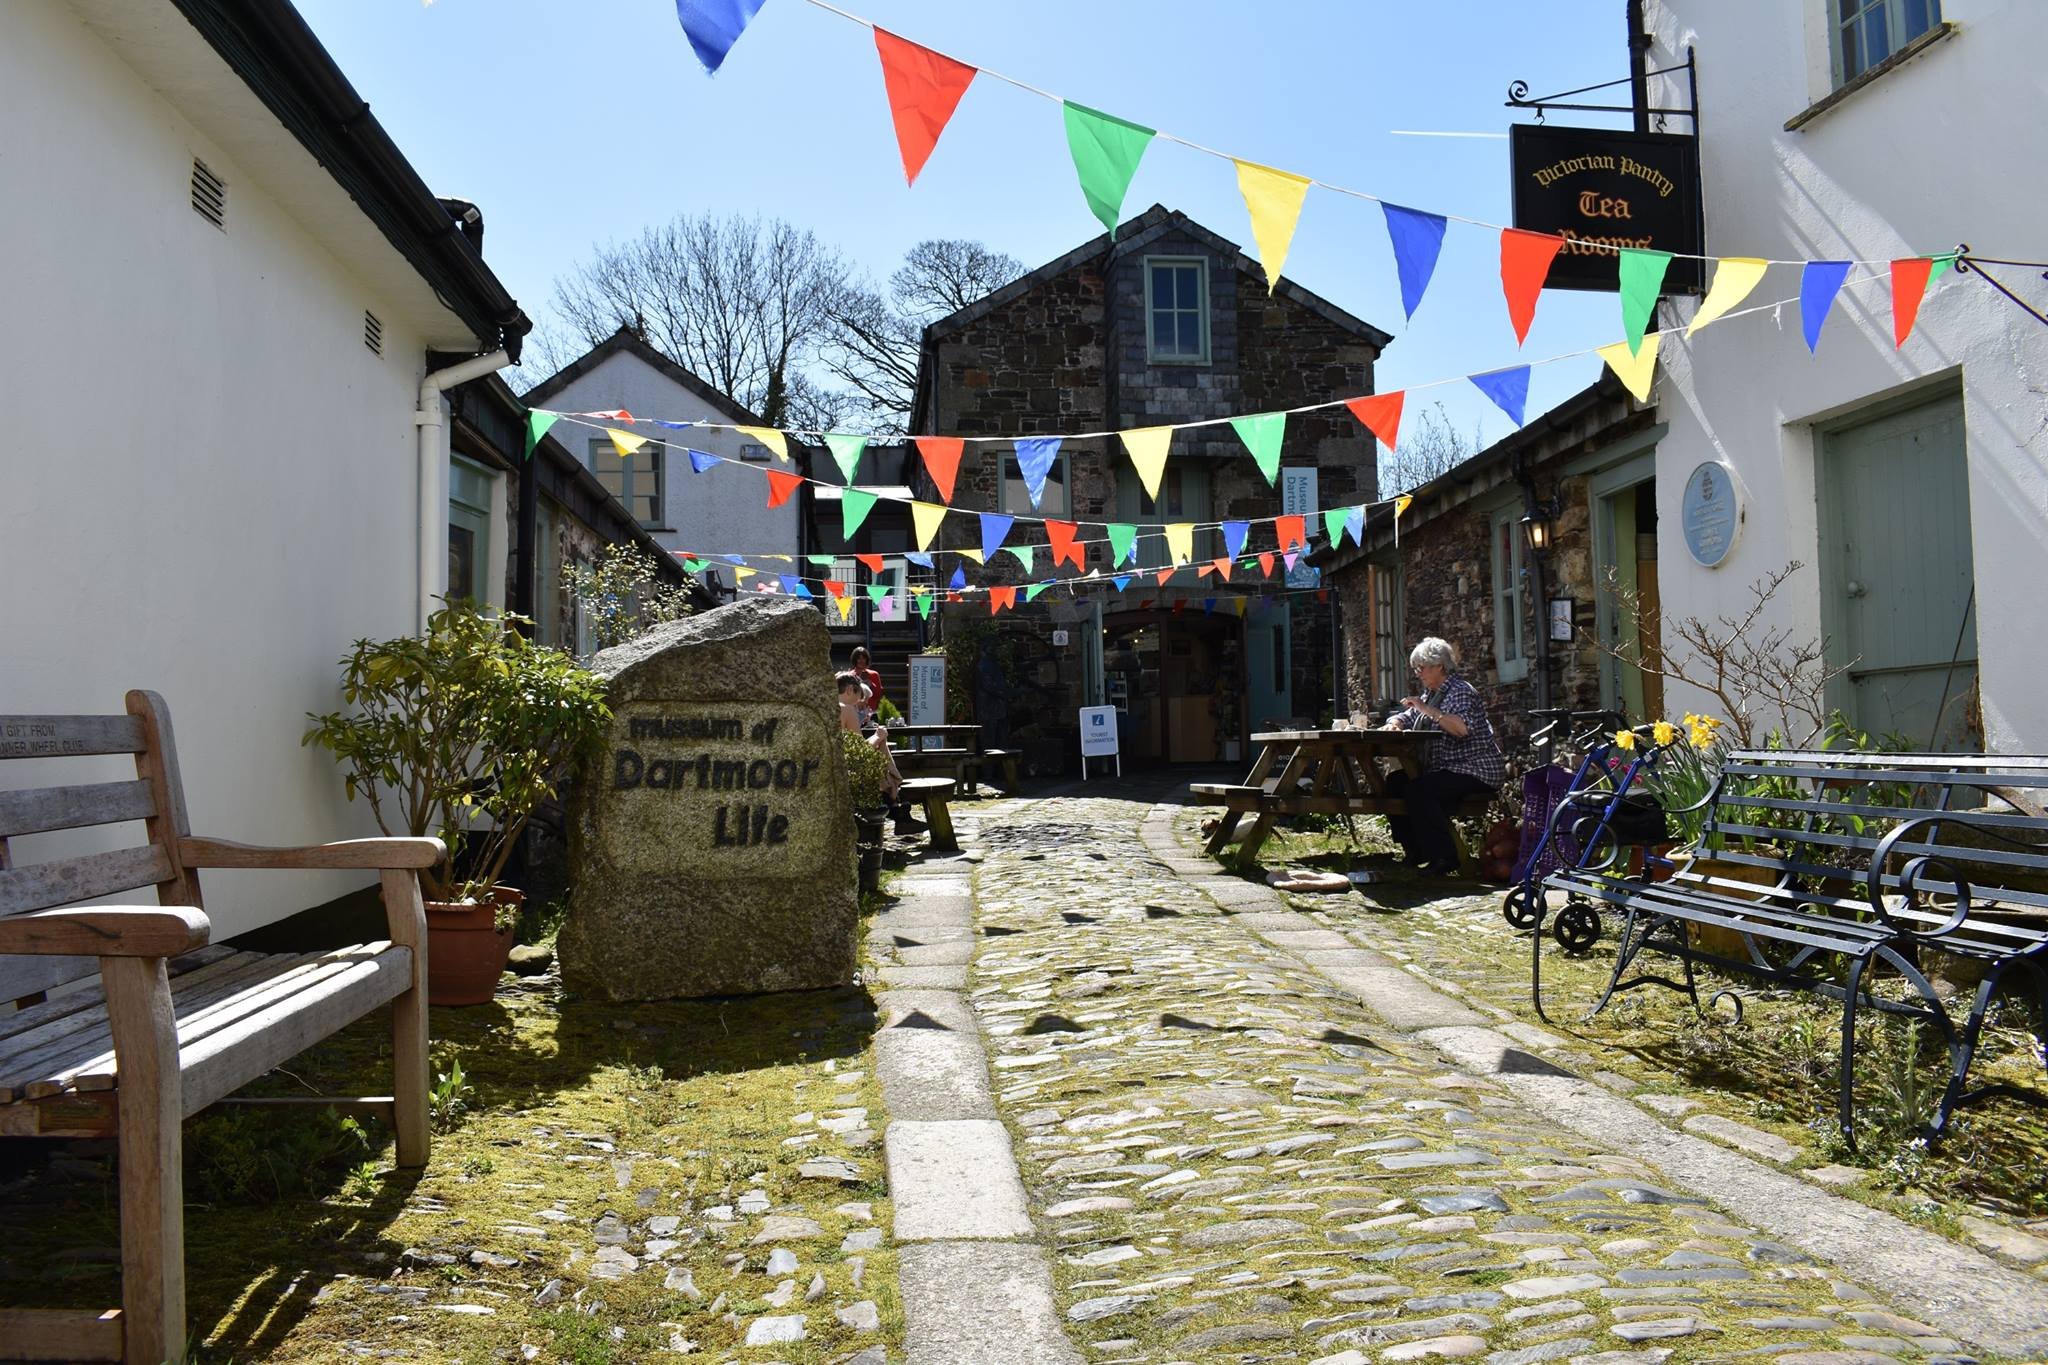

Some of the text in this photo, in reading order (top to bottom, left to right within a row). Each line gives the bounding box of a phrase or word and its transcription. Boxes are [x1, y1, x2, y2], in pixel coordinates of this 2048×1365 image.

[1532, 153, 1676, 198] Victorian Pantry
[1579, 190, 1632, 219] Tea
[1299, 476, 1308, 521] Museu
[912, 666, 920, 720] Dartmoor Life
[7, 725, 26, 737] GIFT
[31, 724, 56, 737] FROM
[752, 717, 780, 744] of
[616, 750, 820, 790] Dartmoor
[715, 804, 790, 847] Life
